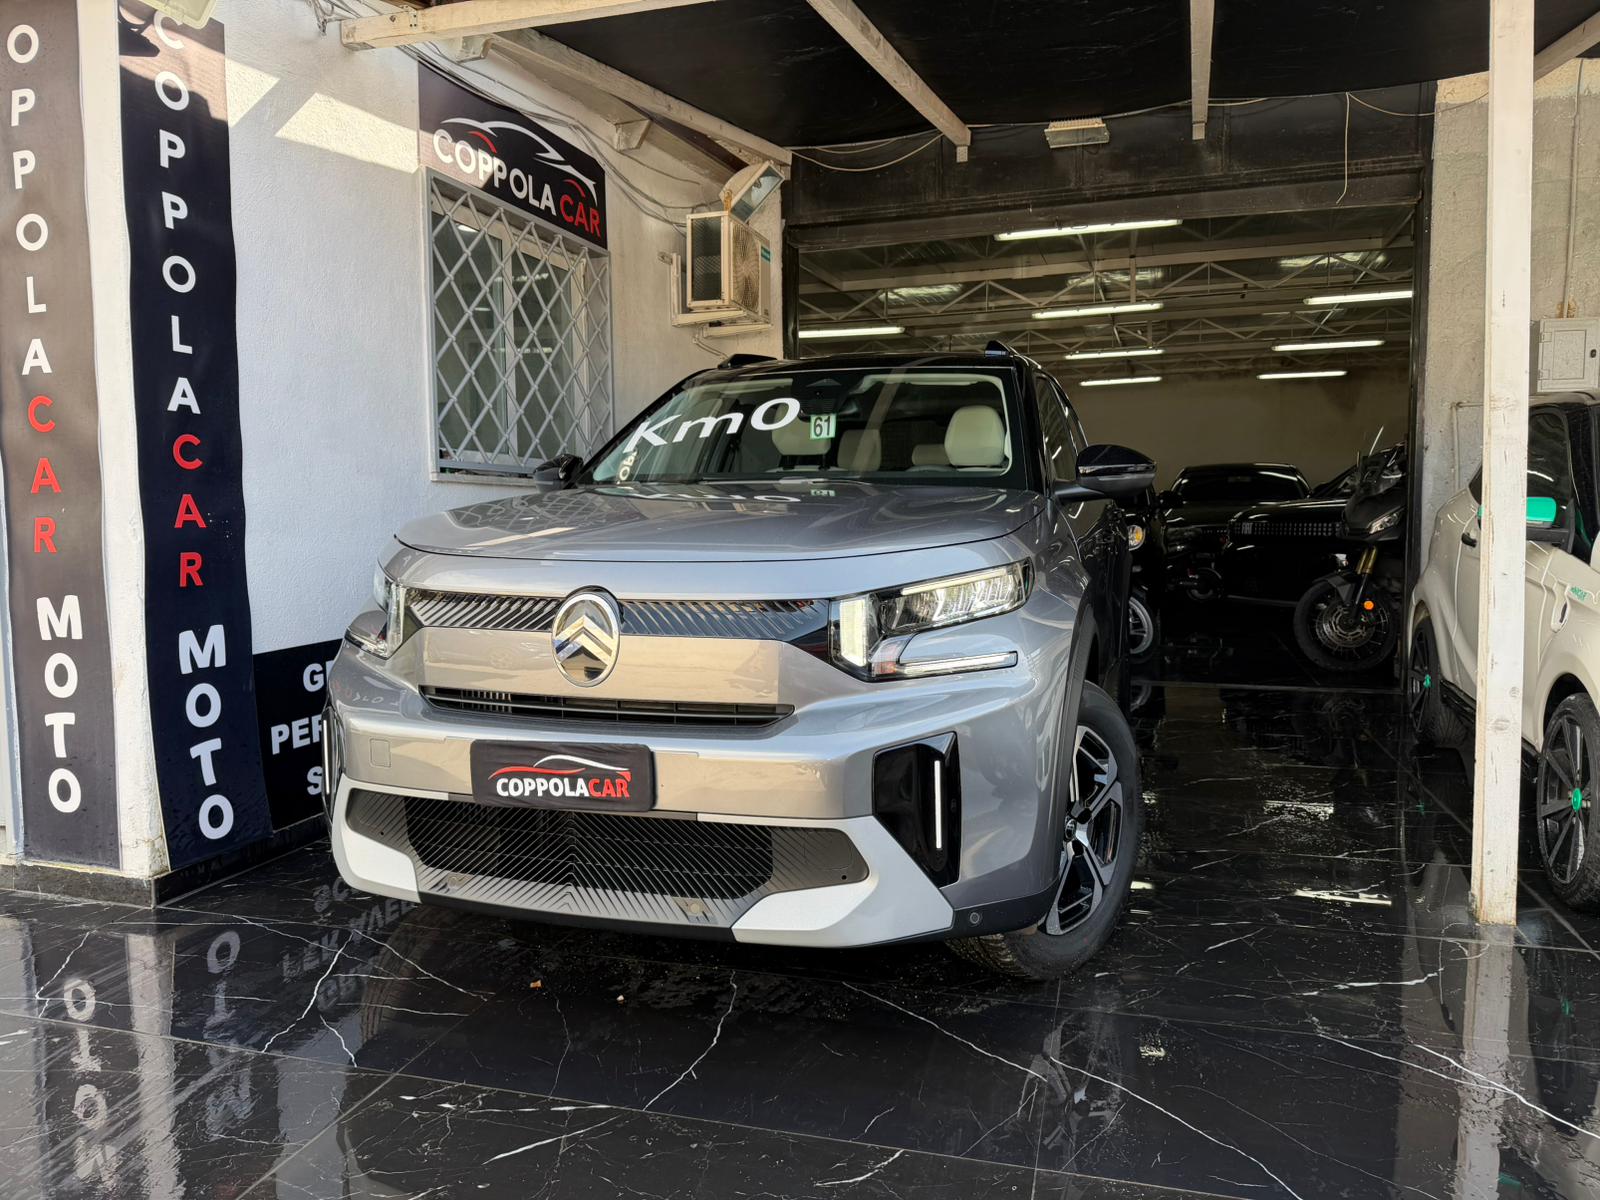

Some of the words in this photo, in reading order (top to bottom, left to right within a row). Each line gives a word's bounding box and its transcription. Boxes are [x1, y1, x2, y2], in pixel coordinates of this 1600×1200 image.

[813, 416, 832, 437] 61
[303, 660, 334, 692] G
[37, 595, 83, 813] MOTO
[178, 624, 235, 840] MOTO
[496, 777, 630, 798] COPPOLACAR
